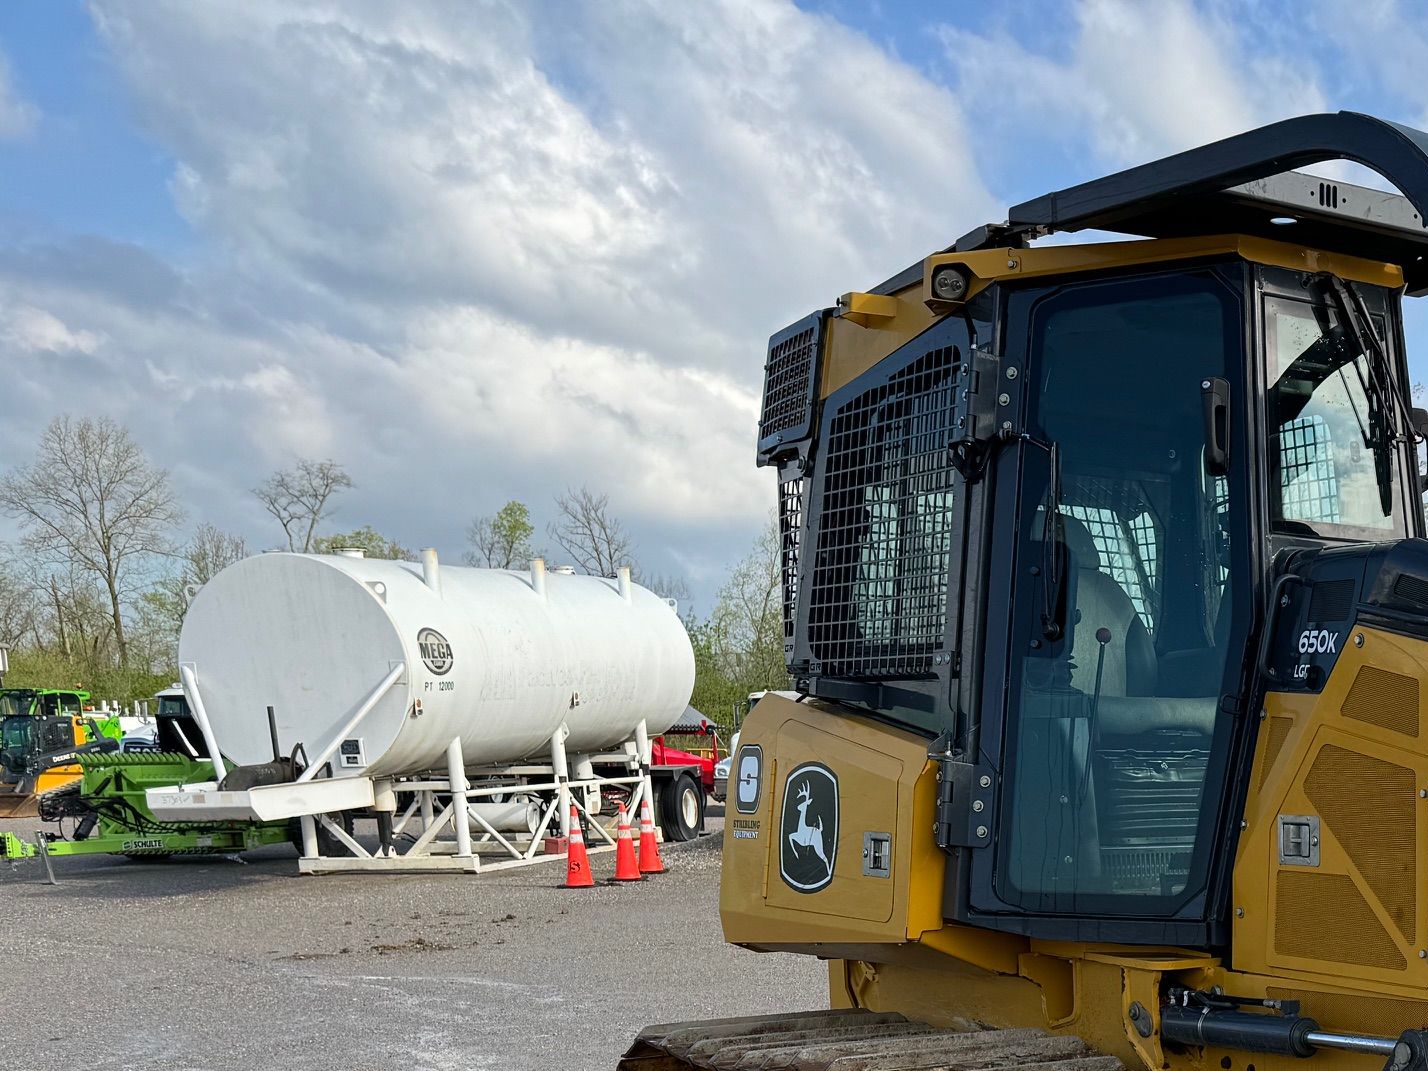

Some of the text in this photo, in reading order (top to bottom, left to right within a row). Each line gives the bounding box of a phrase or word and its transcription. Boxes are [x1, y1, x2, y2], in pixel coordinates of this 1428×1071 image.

[1298, 629, 1339, 654] 650K
[418, 642, 454, 660] MEGA
[438, 681, 455, 692] 12000
[733, 819, 761, 830] STRIBLING
[733, 829, 759, 839] EQUIPMENT
[133, 839, 163, 848] SCHULTE
